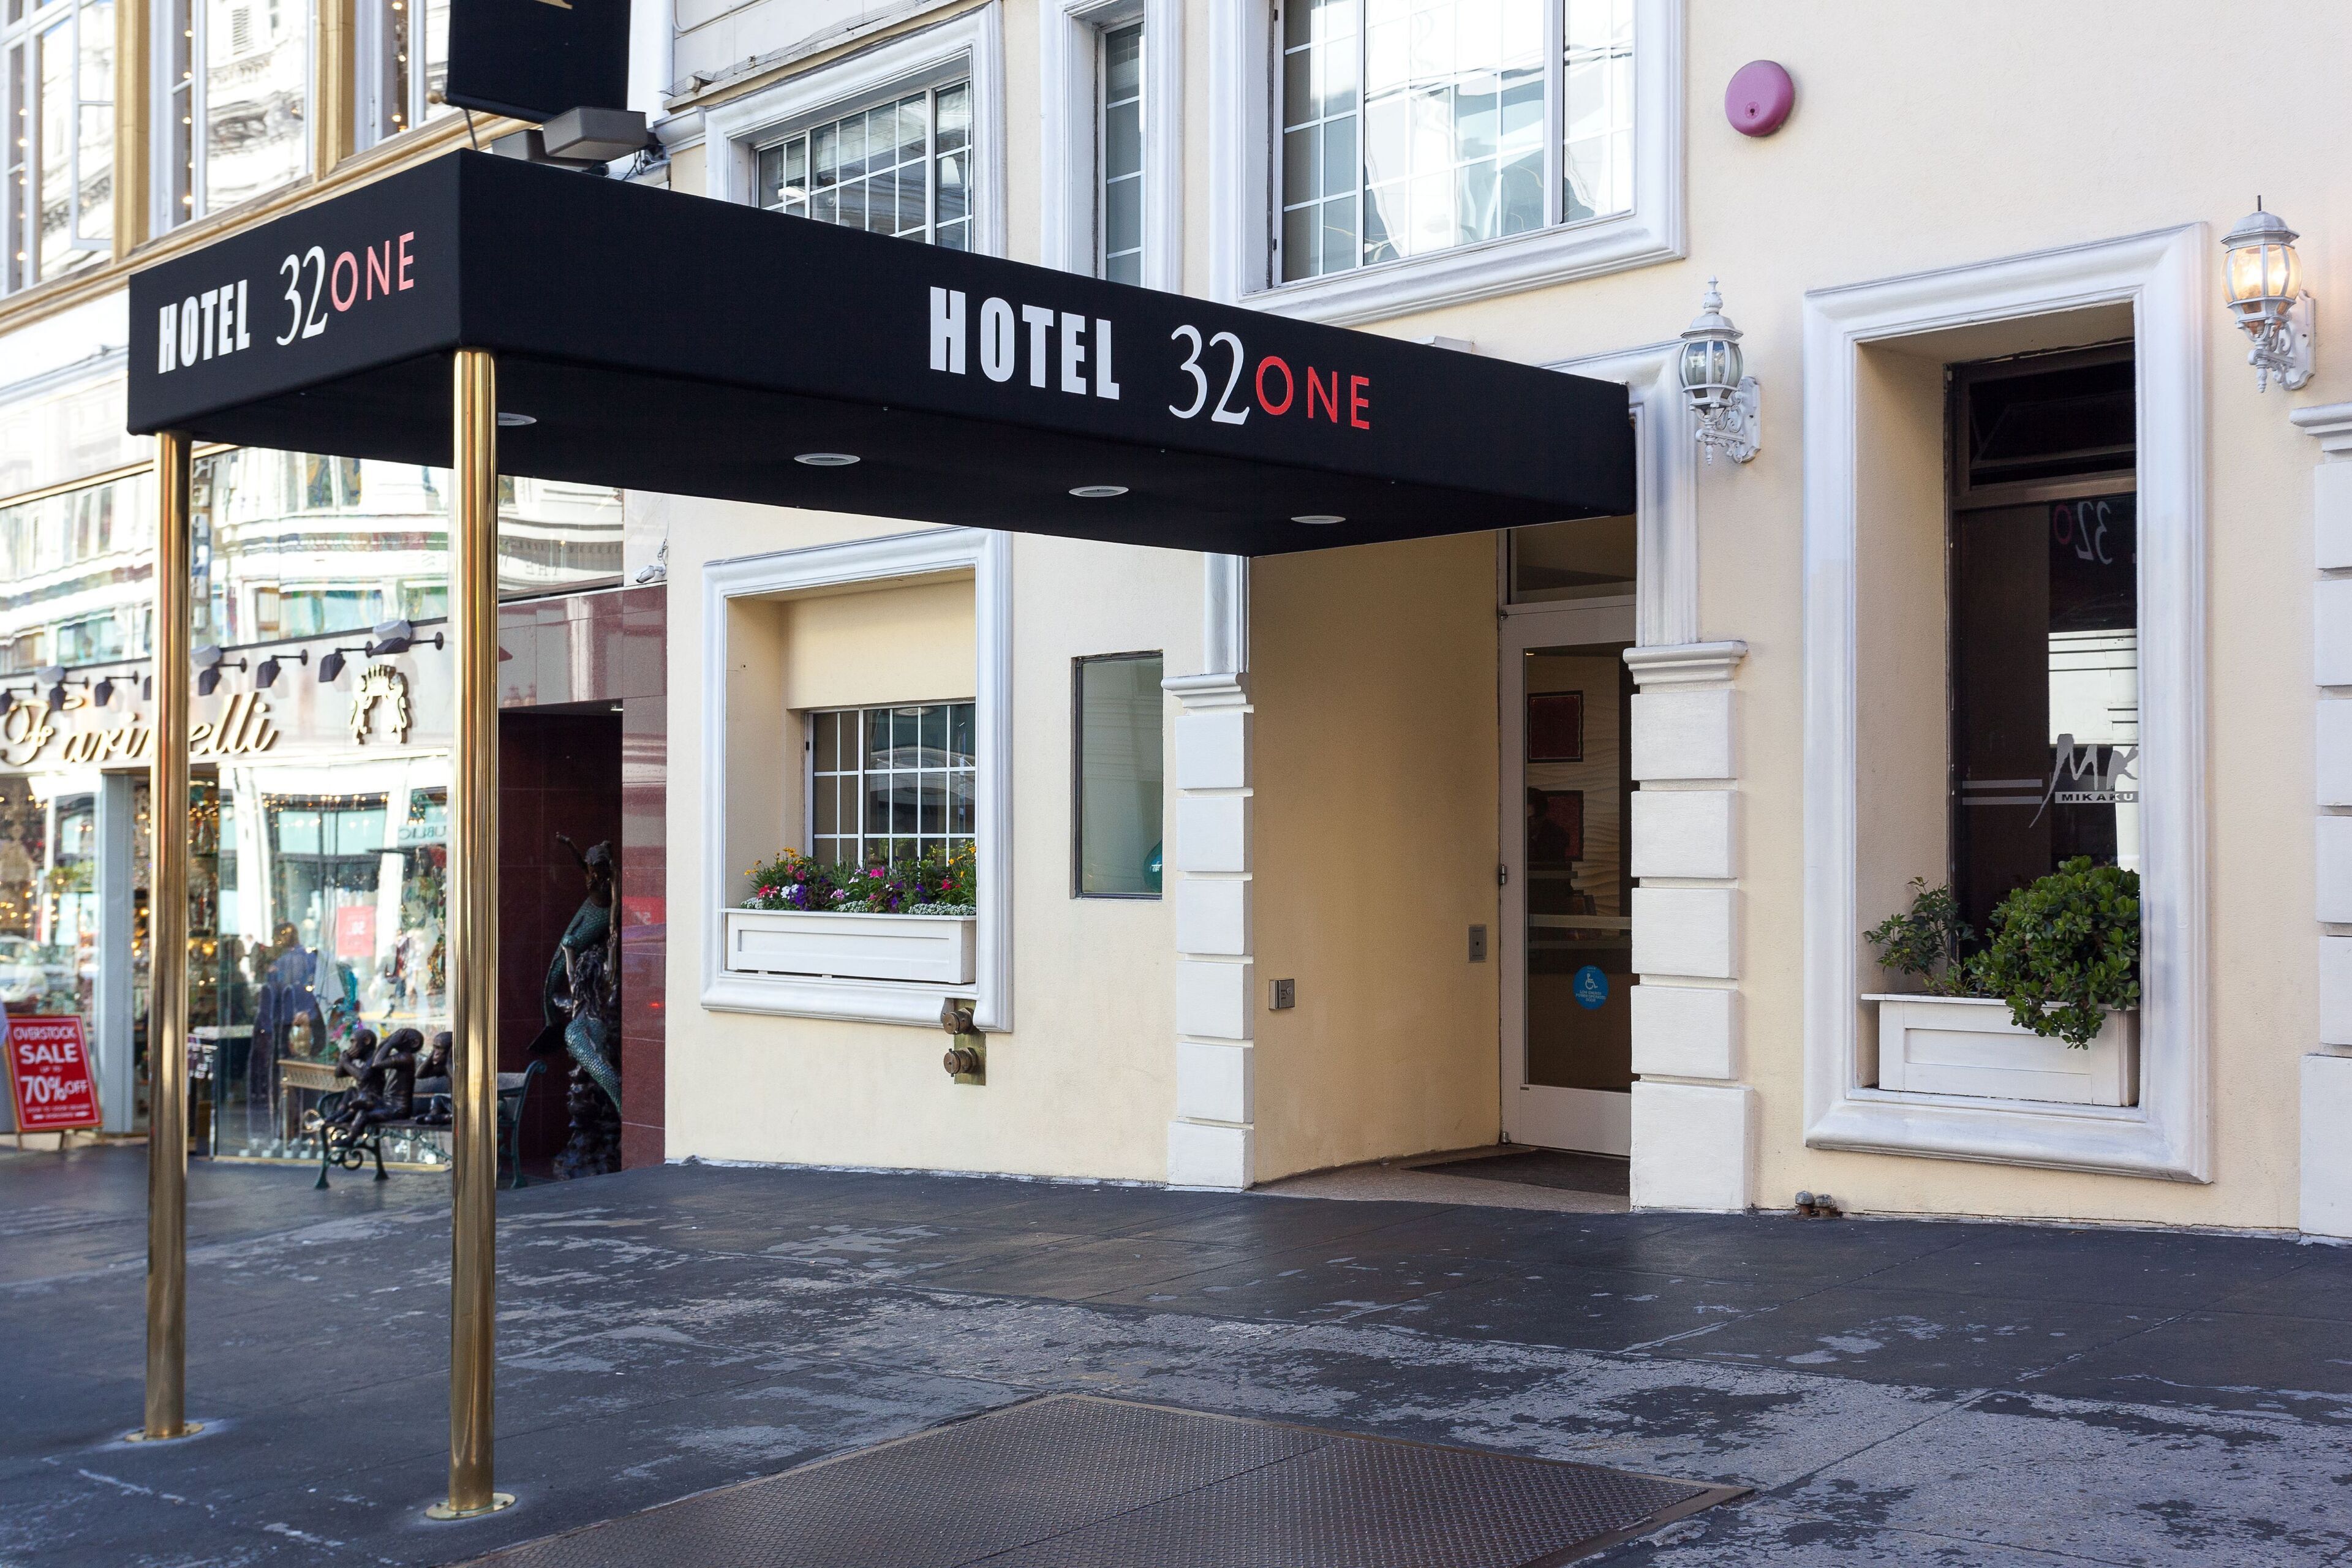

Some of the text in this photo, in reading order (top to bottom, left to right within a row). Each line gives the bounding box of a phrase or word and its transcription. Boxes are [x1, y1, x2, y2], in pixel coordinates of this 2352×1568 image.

[159, 232, 414, 374] HOTEL 32ONE
[930, 286, 1370, 429] HOTEL 32ONE
[0, 692, 276, 766] Farielli
[13, 1026, 77, 1041] OVERSTOCK
[19, 1043, 79, 1065] SALE
[20, 1075, 88, 1104] 70% OFF
